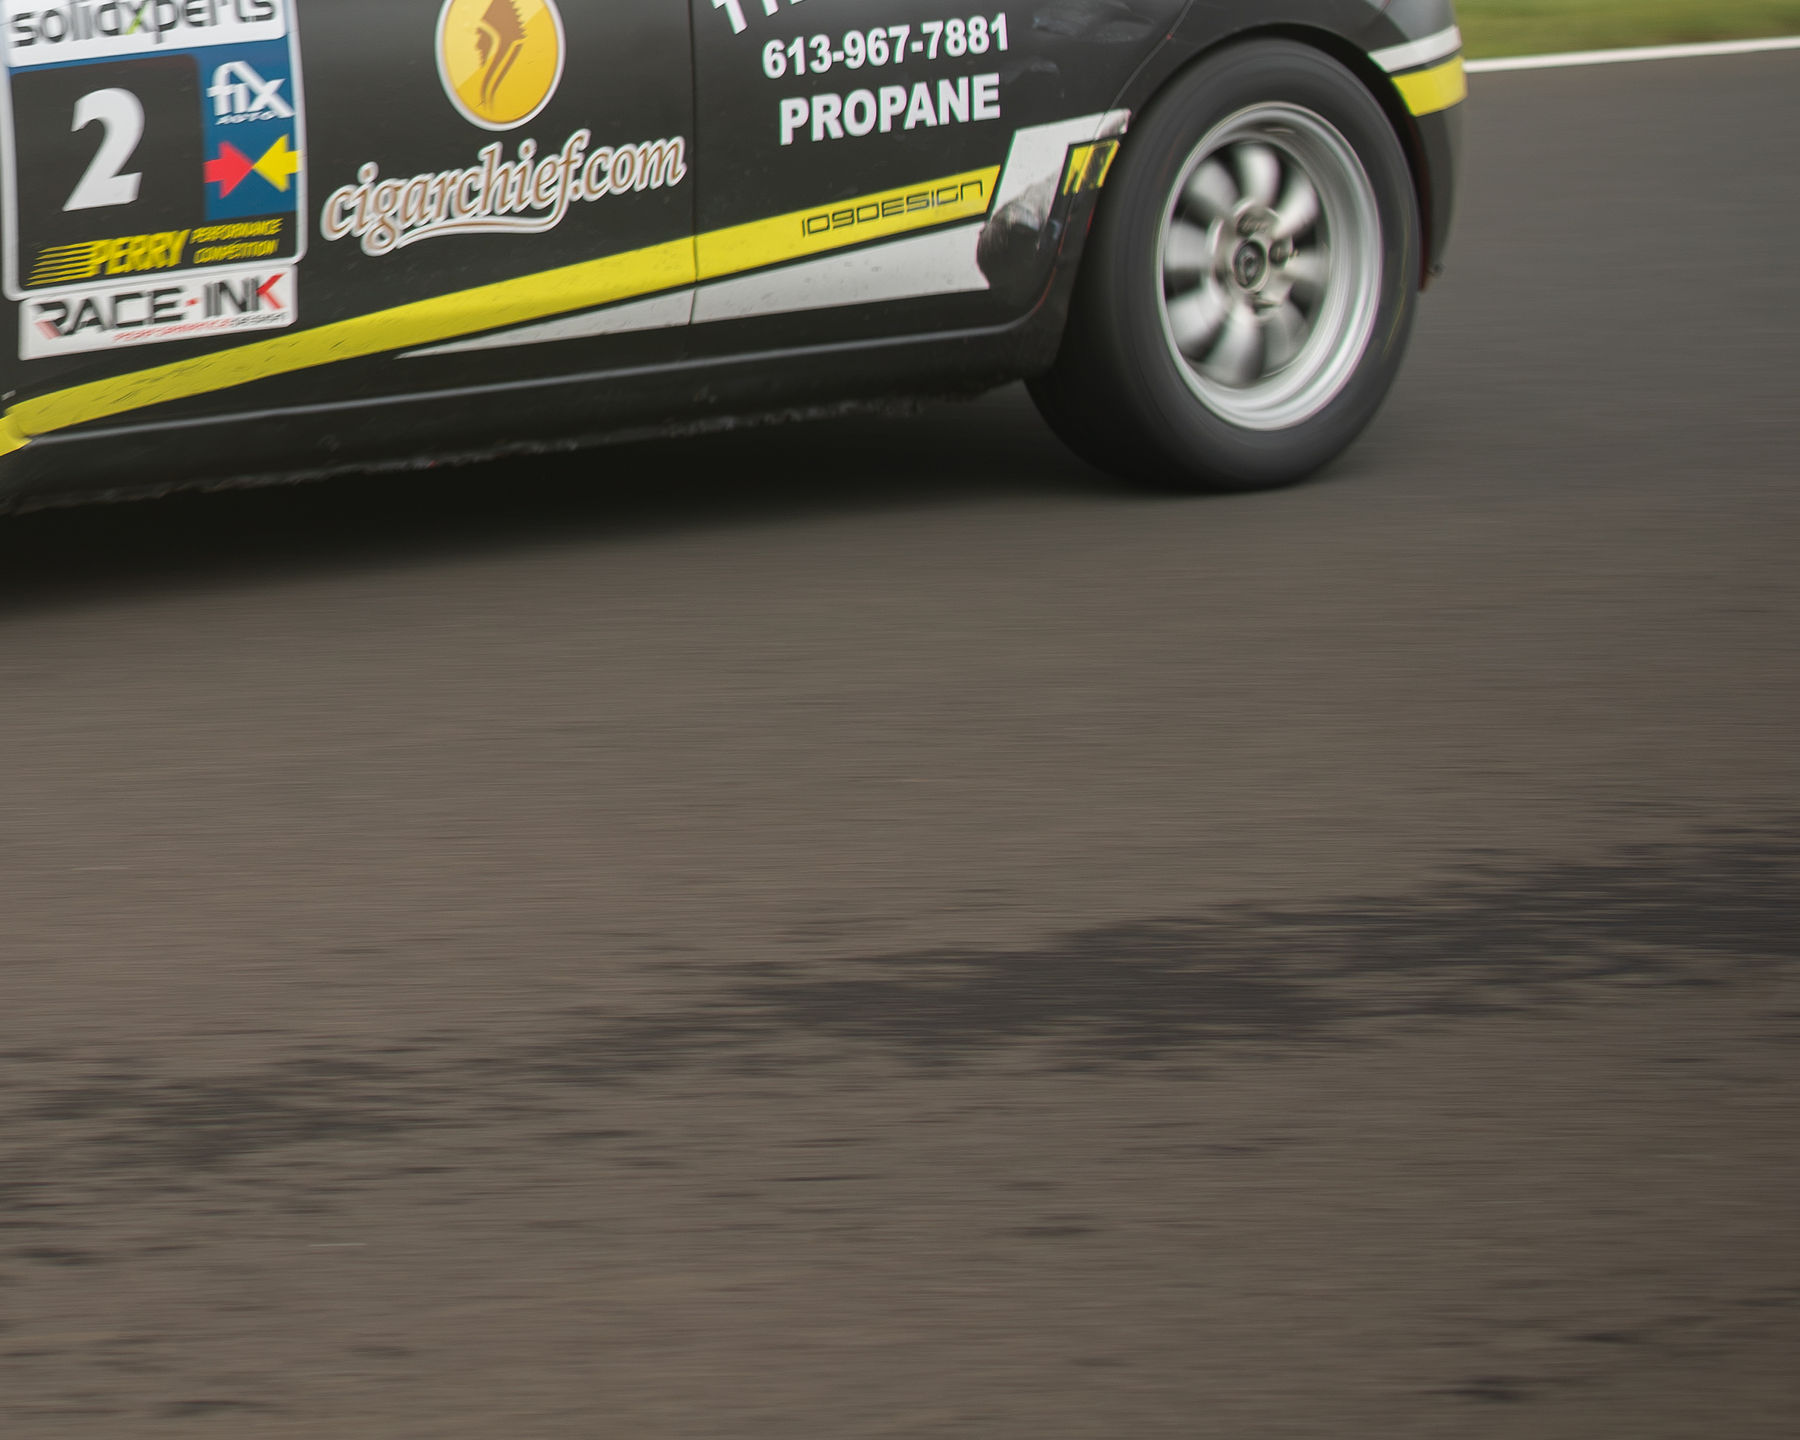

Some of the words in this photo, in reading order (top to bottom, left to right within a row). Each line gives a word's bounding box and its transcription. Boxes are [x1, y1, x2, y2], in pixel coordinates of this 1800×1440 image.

[761, 12, 1008, 79] 613-967-7881
[779, 72, 1000, 146] PROPANE
[62, 87, 146, 211] 2
[320, 129, 687, 256] cigarchief.com
[90, 228, 192, 277] PERRY
